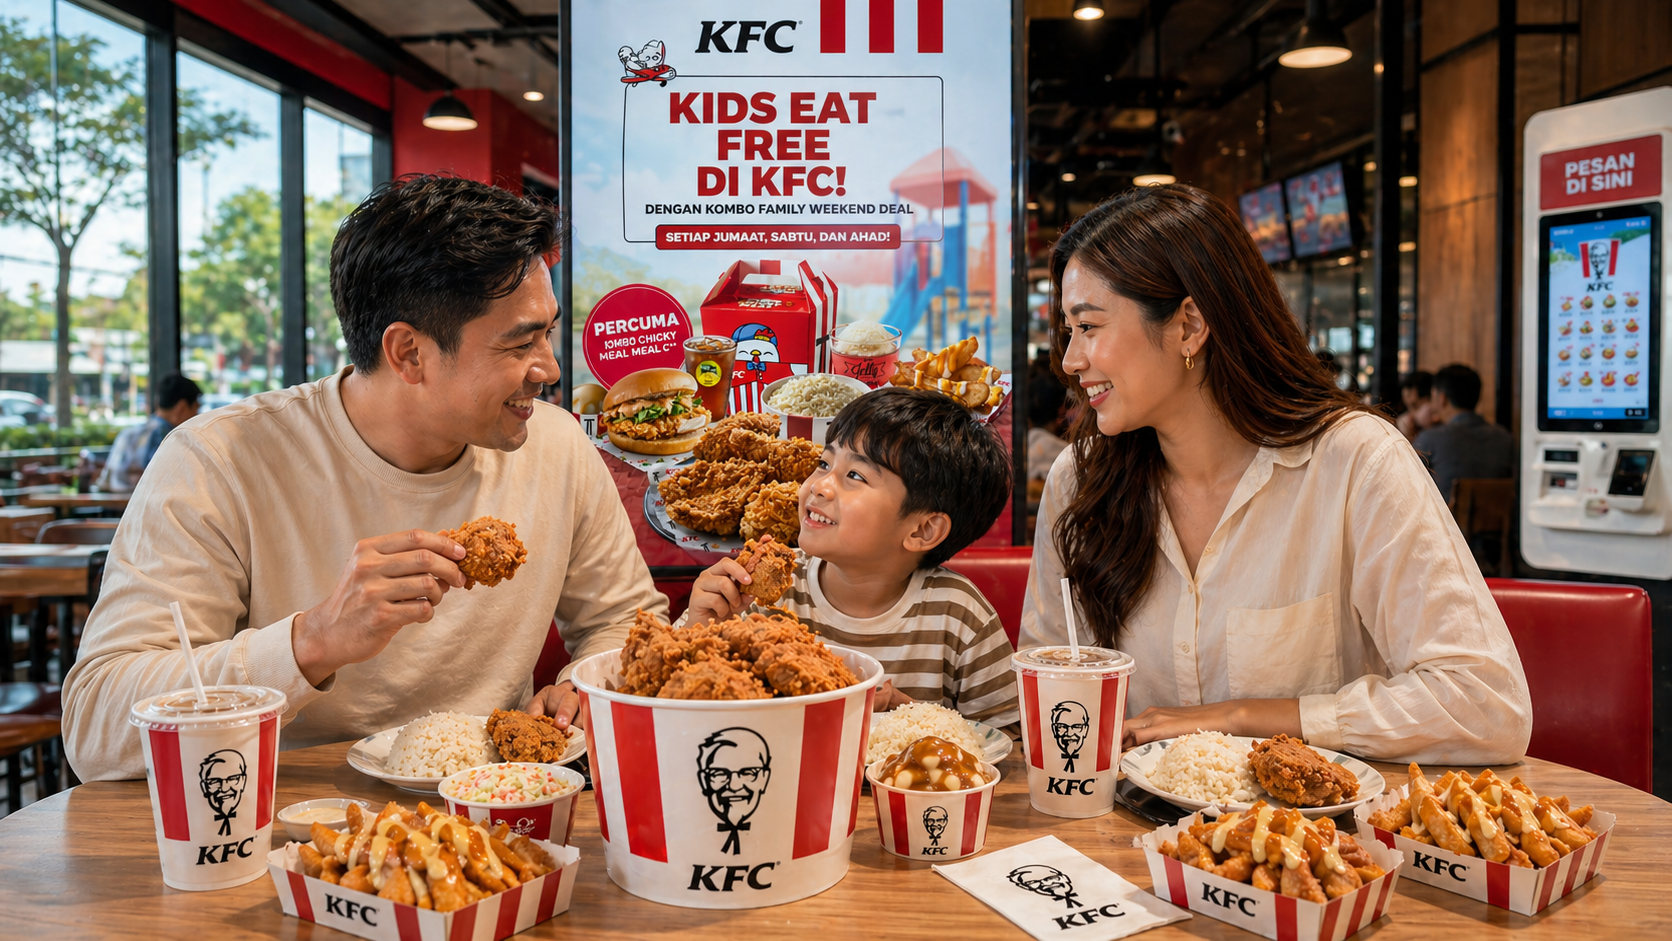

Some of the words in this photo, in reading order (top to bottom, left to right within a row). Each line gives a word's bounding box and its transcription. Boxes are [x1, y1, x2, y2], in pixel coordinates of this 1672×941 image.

[695, 20, 797, 53] KFC
[669, 91, 777, 124] KIDS
[790, 92, 877, 124] EAT
[718, 129, 830, 160] FREE
[1565, 152, 1635, 178] PESAN
[697, 166, 739, 196] DI
[752, 166, 846, 197] KFC!
[1566, 180, 1587, 195] DI
[1591, 171, 1633, 191] SINI
[645, 204, 701, 215] DENGAN
[705, 204, 755, 215] KOMBO
[758, 204, 806, 214] FAMILY
[810, 204, 876, 214] WEEKEND
[879, 204, 914, 214] DEAL
[665, 232, 710, 242] SETIAP
[713, 232, 768, 243] JUMAAT,
[770, 232, 816, 243] SABTU,
[819, 232, 847, 242] DAN
[850, 231, 890, 242] AHAD!
[594, 312, 679, 336] PERCUMA
[638, 331, 677, 345] CHICKY
[599, 349, 629, 361] MEAL
[631, 344, 661, 356] MEAL
[731, 371, 745, 379] FC
[1047, 776, 1095, 796] KFC
[196, 836, 253, 865] KFC
[921, 846, 948, 856] KFC
[687, 862, 775, 892] KFC
[1412, 850, 1468, 883] KFC
[325, 893, 378, 927] KFC
[1201, 882, 1257, 918] KFC
[1052, 903, 1126, 931] KFC
